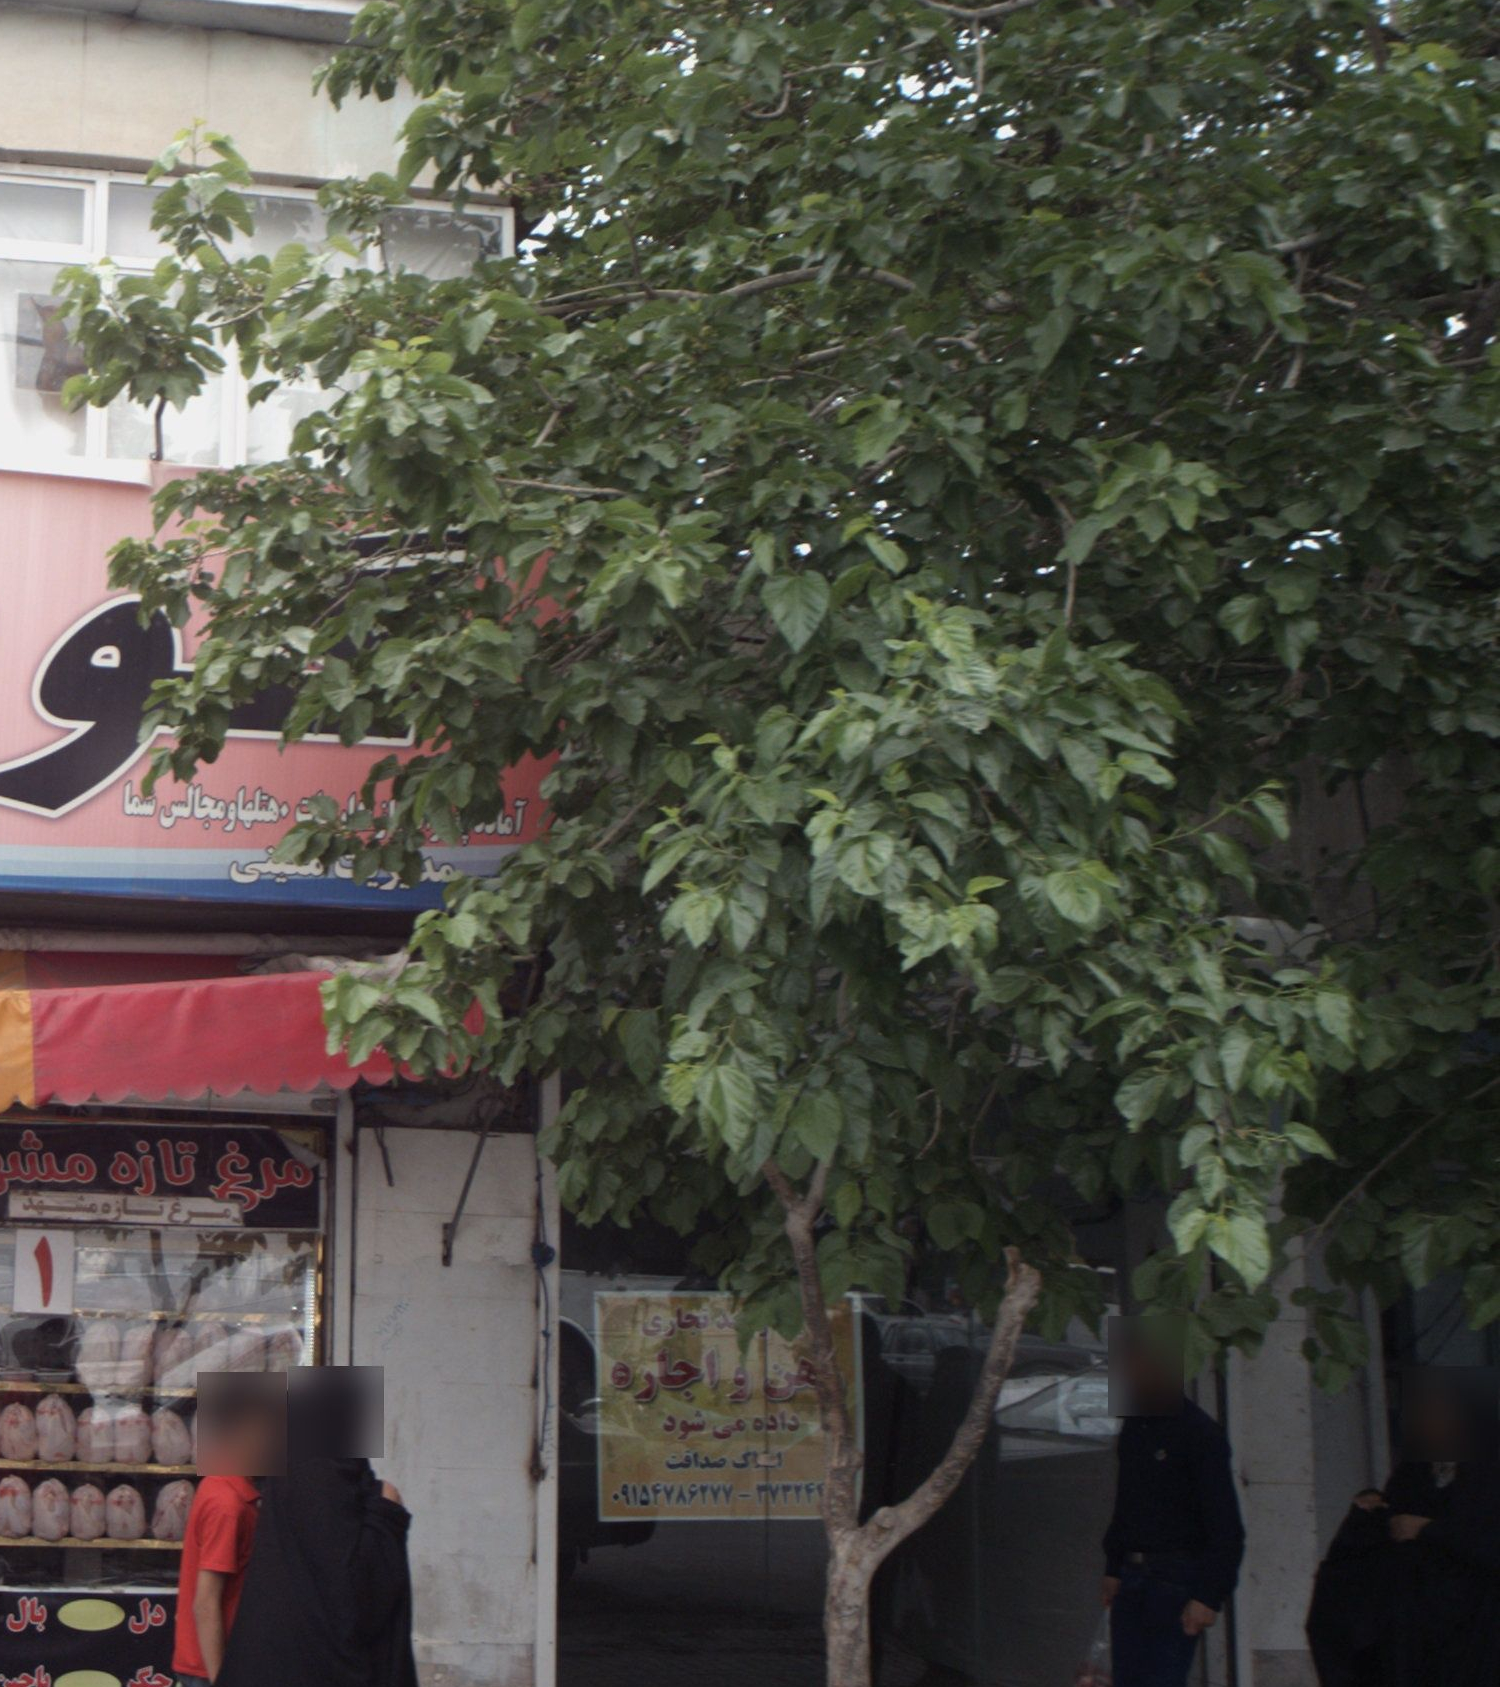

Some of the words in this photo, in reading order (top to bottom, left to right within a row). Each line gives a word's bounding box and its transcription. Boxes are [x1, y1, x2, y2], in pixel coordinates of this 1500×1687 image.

[109, 1139, 198, 1197] تازه
[210, 1141, 314, 1212] مرغ
[168, 1198, 232, 1224] مرغ
[610, 1348, 719, 1402] اجاره
[6, 1595, 48, 1633] بال
[128, 1597, 167, 1635] دل
